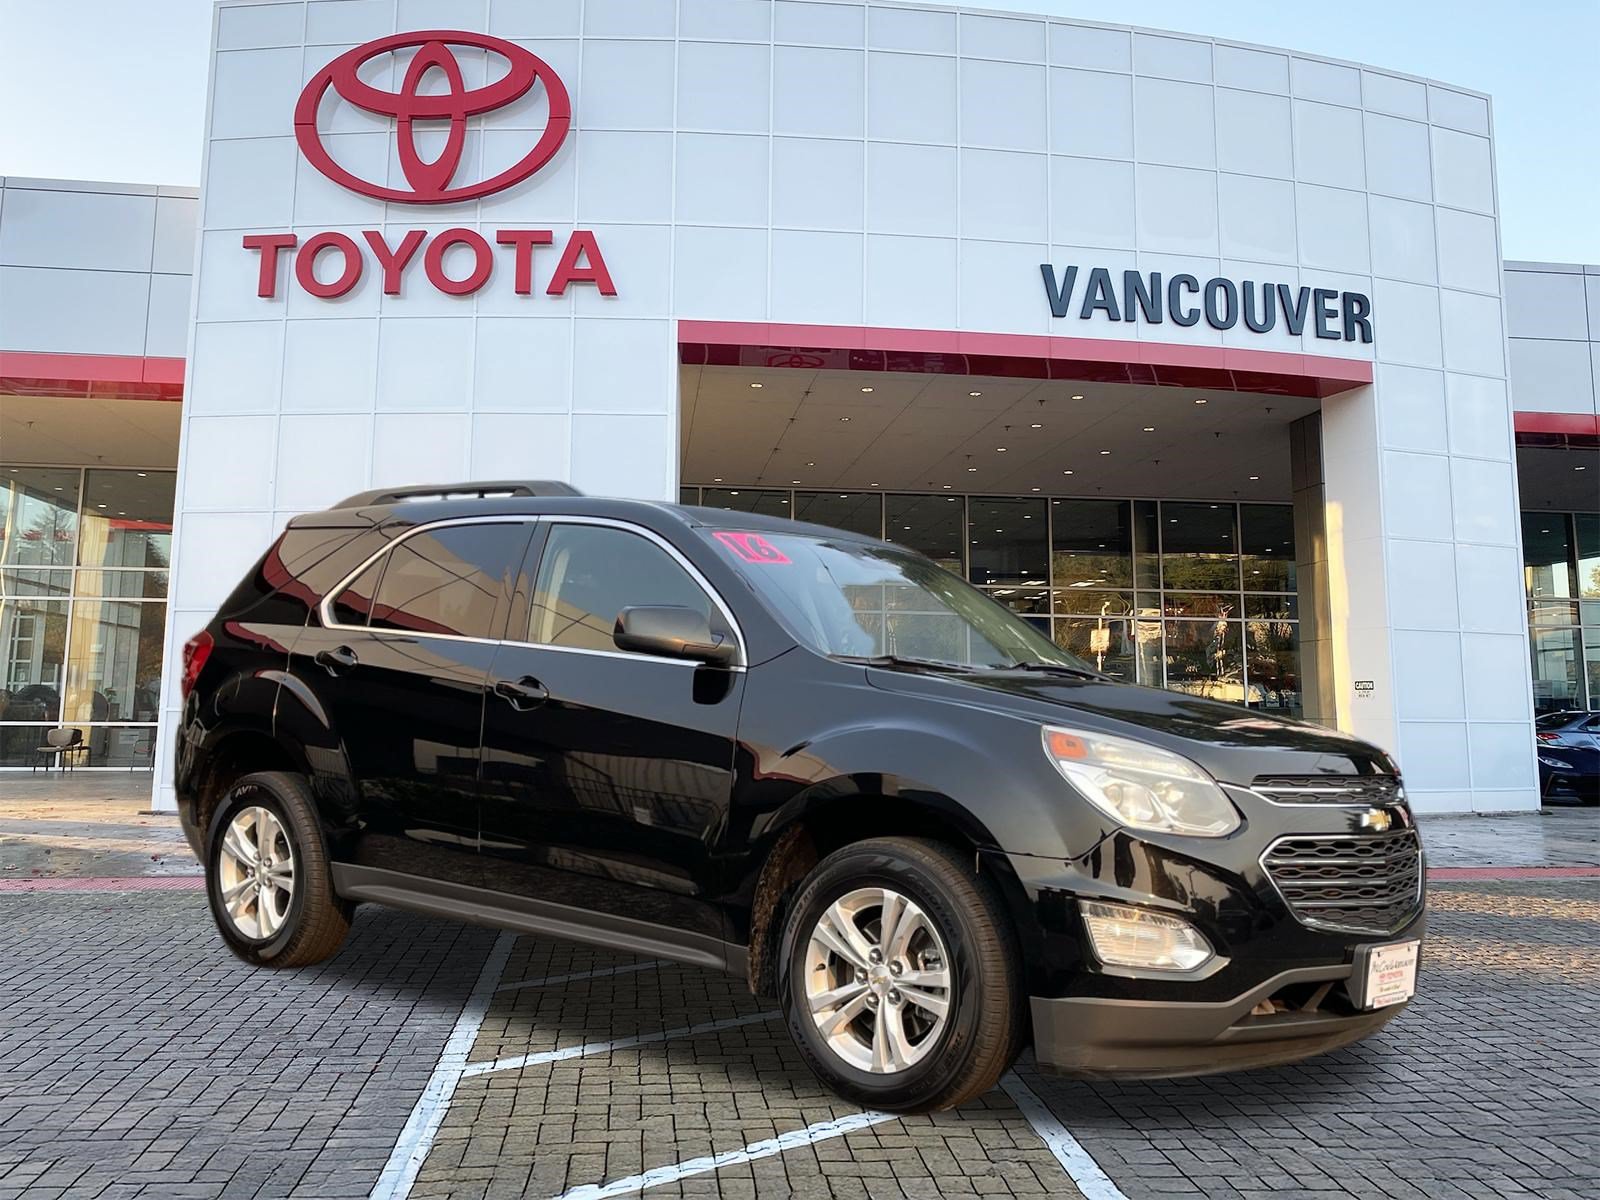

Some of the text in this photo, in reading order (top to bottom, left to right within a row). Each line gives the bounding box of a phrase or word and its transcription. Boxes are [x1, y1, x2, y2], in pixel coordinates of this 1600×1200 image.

[243, 227, 618, 299] TOYOTA
[1040, 264, 1374, 344] VANCOUVER
[720, 534, 778, 559] 16
